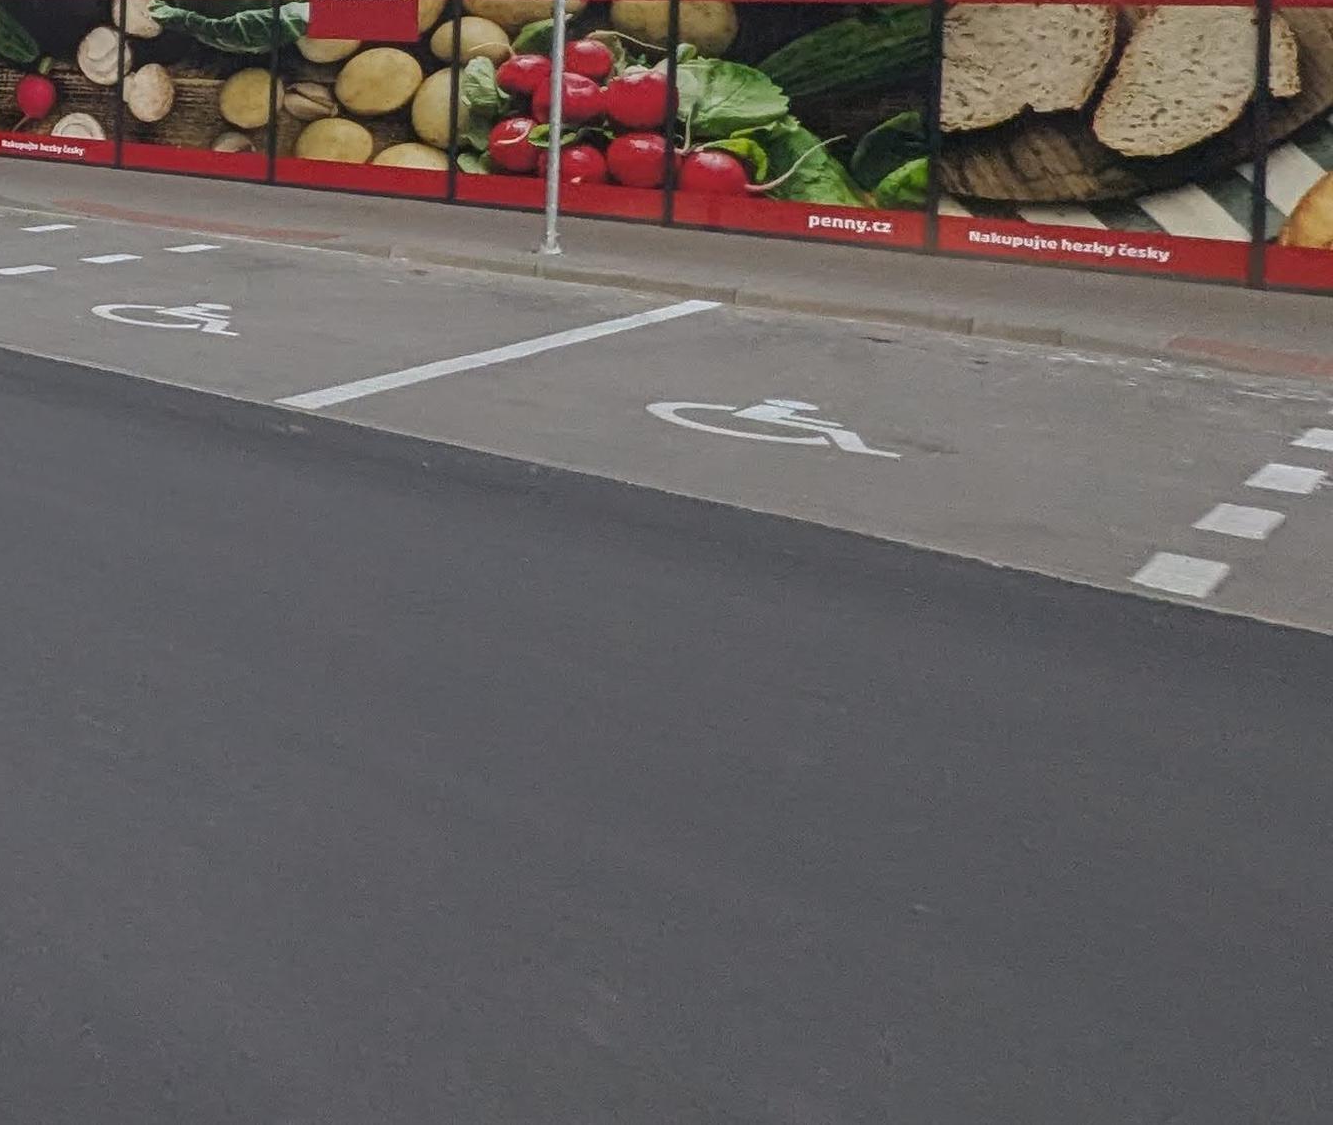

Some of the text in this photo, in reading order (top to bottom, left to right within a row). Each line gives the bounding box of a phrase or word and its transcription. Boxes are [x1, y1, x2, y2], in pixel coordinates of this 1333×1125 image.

[808, 215, 892, 233] penny.cz
[968, 230, 1170, 262] Nakupujte hezky česky
